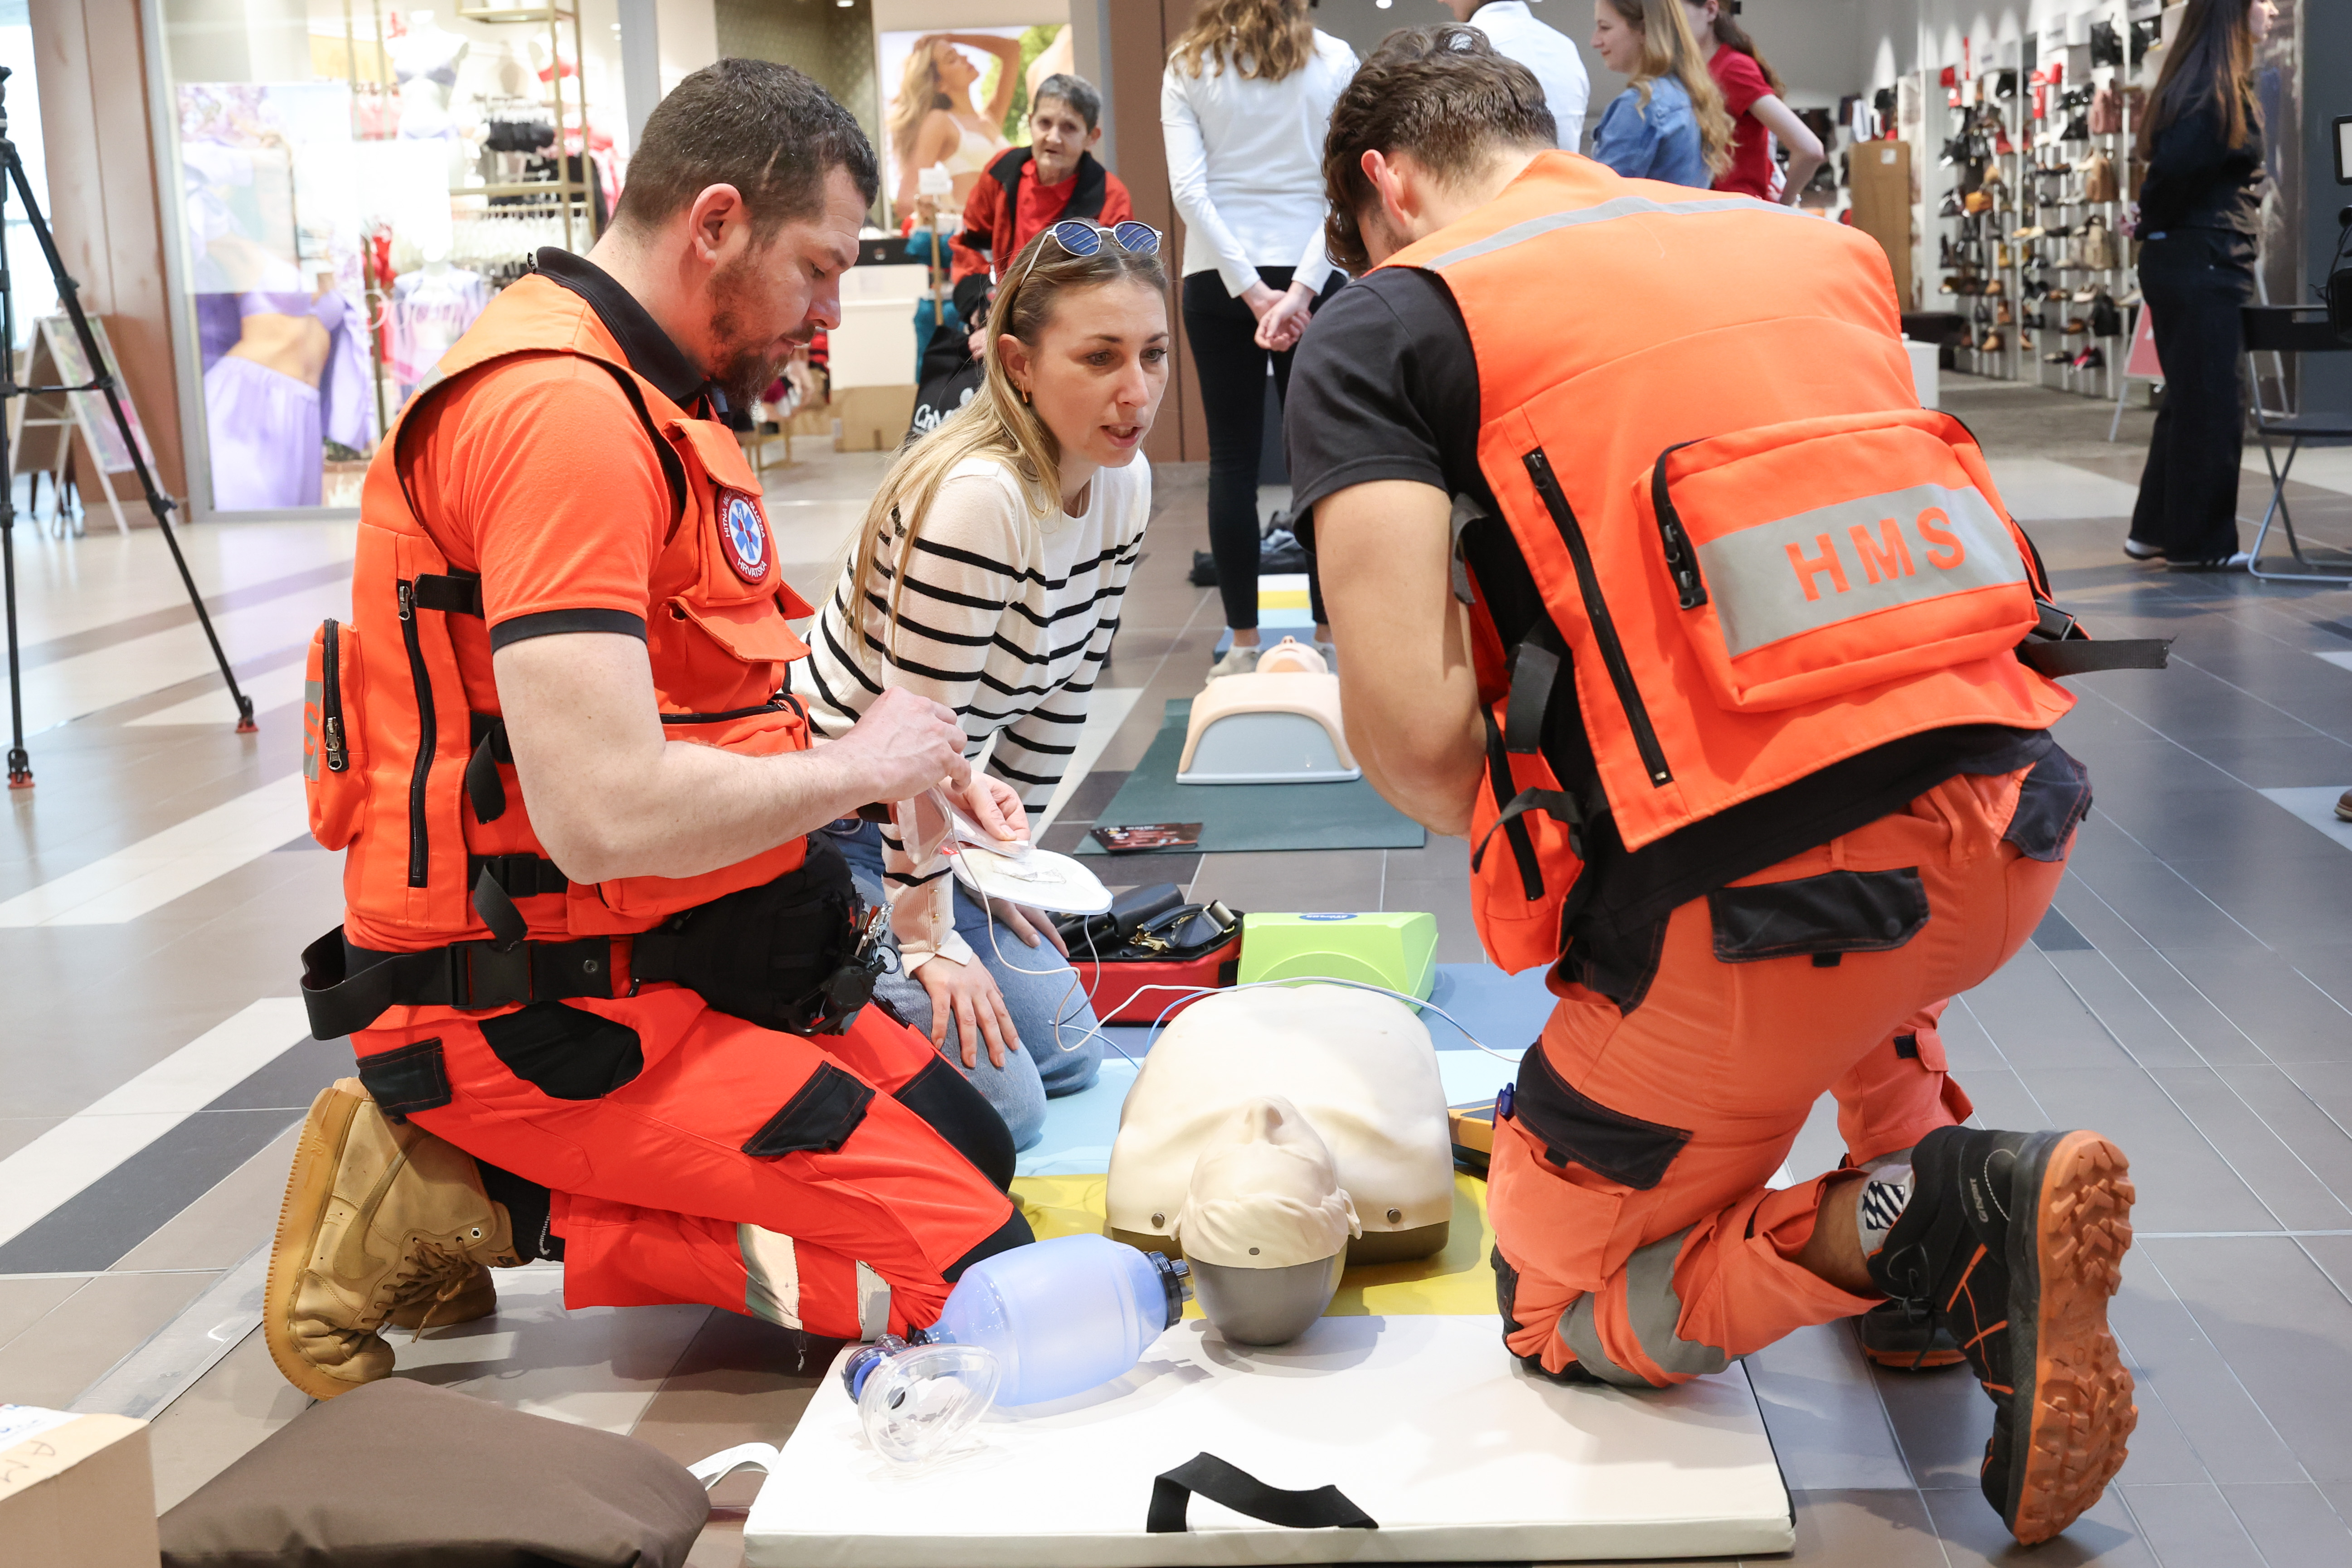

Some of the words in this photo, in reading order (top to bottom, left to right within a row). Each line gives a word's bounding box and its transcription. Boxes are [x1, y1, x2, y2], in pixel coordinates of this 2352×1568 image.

[723, 488, 748, 507] MEDIKA
[722, 508, 730, 537] HITNA
[1784, 506, 1966, 602] HMS
[738, 558, 767, 578] HRVATSKA
